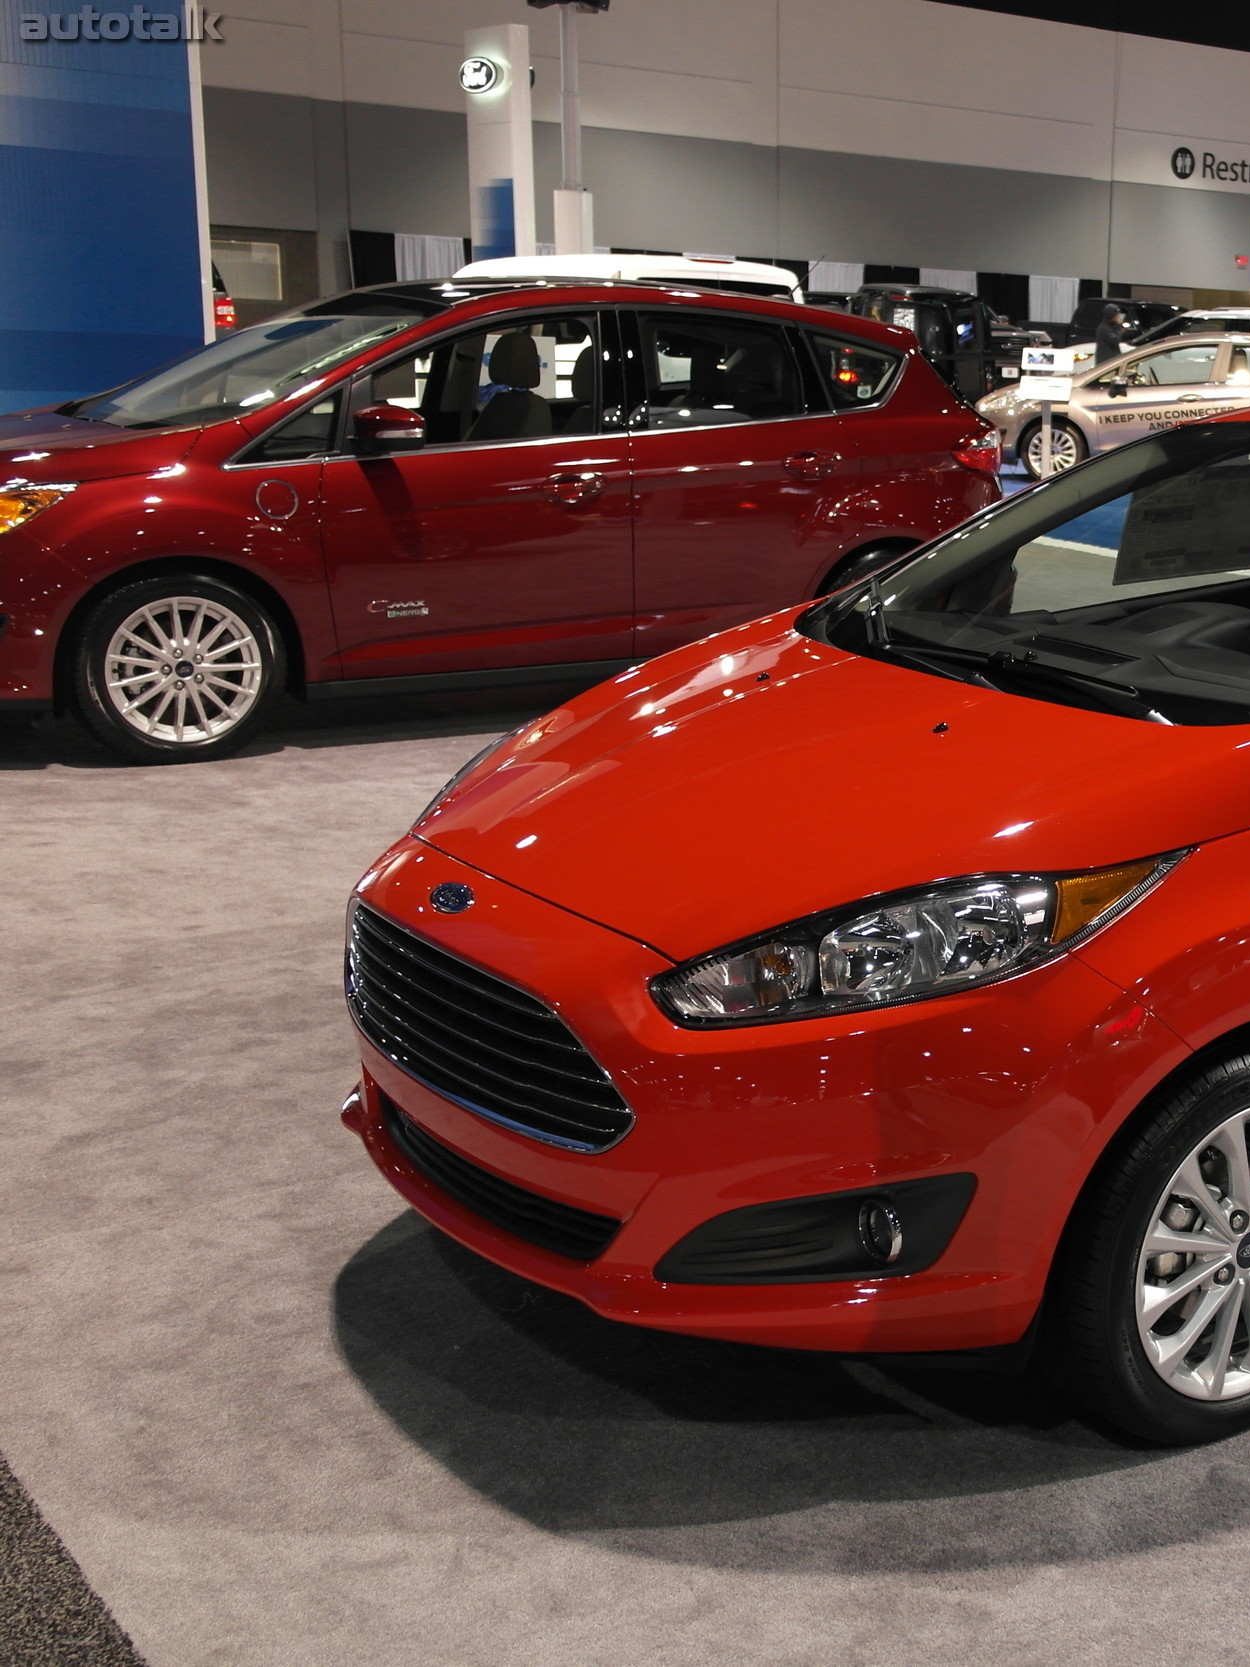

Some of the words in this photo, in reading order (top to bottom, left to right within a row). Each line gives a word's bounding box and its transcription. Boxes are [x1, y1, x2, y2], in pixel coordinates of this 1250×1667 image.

[1105, 413, 1135, 424] KEEP
[1137, 411, 1162, 421] YOU
[1149, 421, 1173, 431] AND
